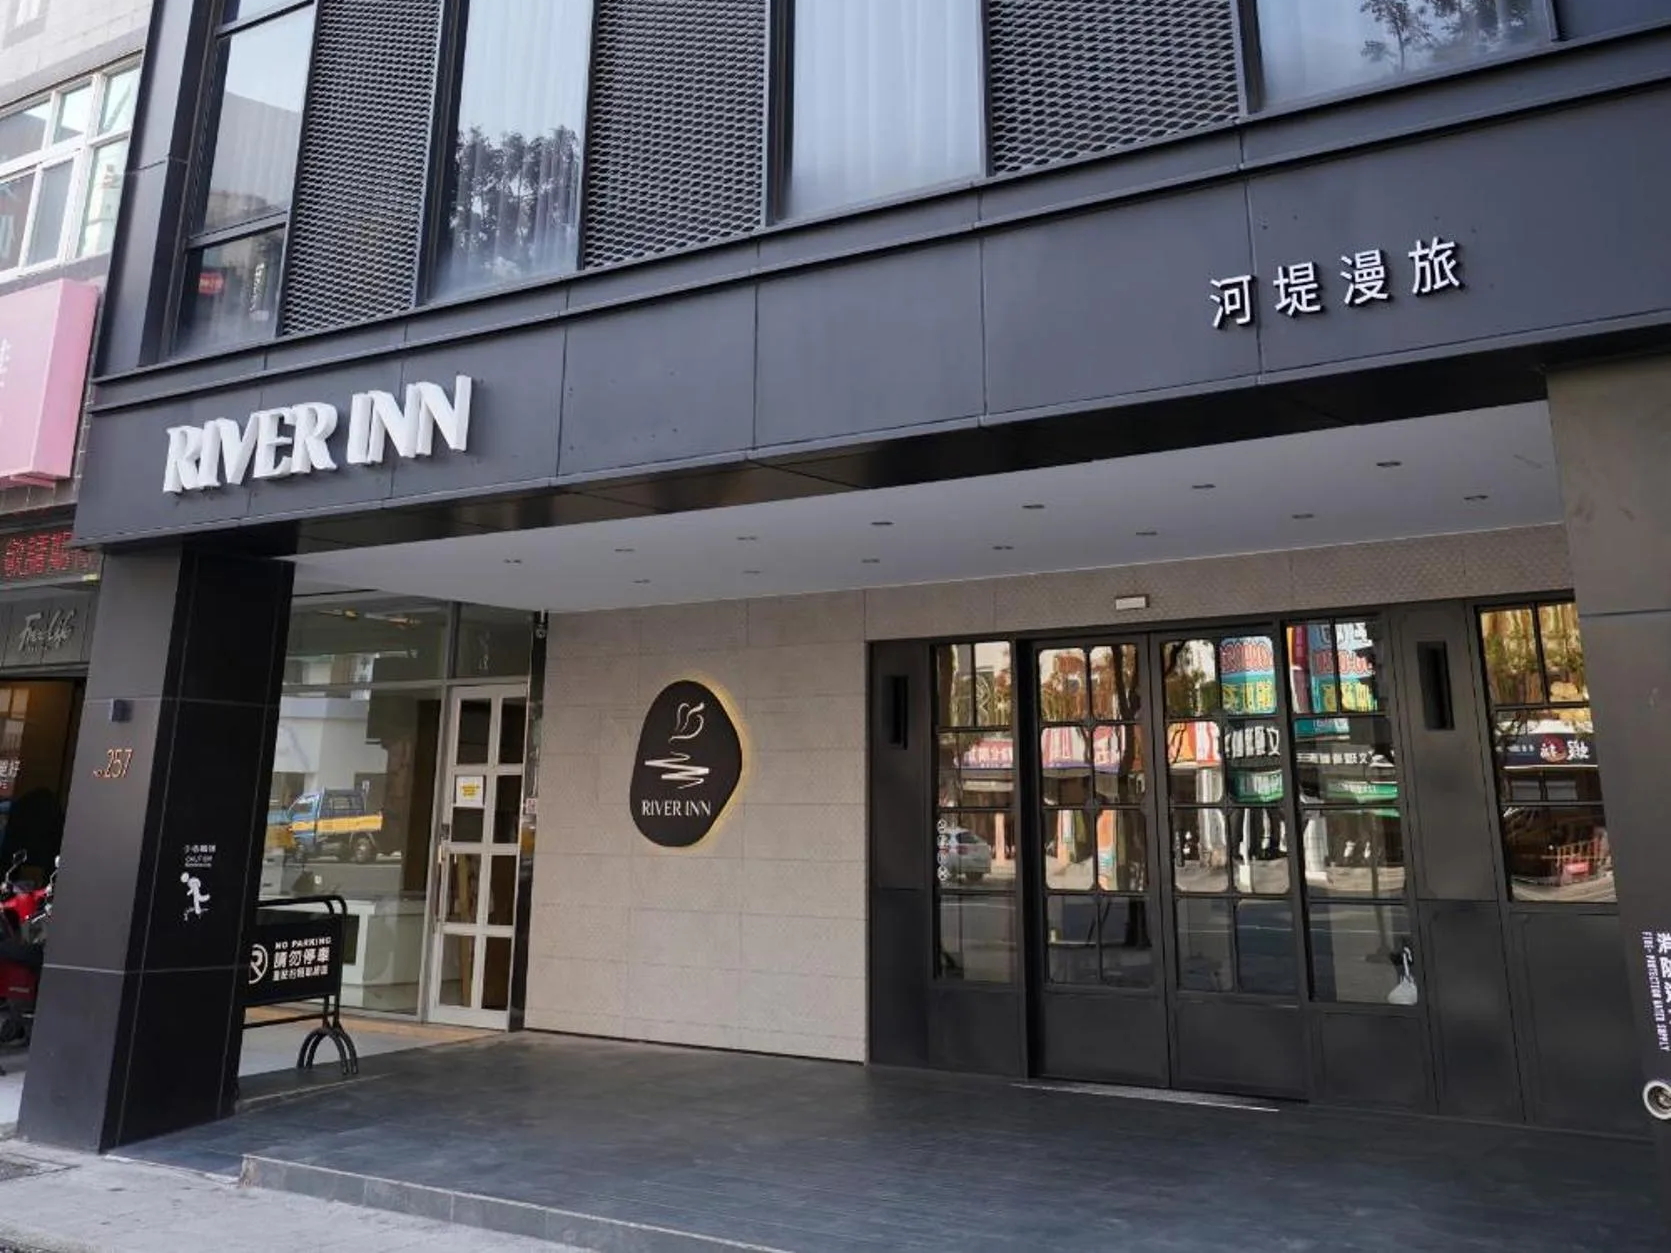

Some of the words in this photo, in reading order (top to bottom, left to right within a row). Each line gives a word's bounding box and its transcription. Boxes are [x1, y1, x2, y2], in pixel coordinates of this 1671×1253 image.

[1209, 236, 1461, 328] 河堤漫旅
[163, 401, 337, 493] RIVER
[347, 374, 472, 465] INN
[641, 799, 681, 817] RIVER
[684, 800, 712, 817] INN
[275, 941, 288, 950] NO
[291, 936, 332, 948] PARKING
[273, 946, 330, 969] 請勿停車
